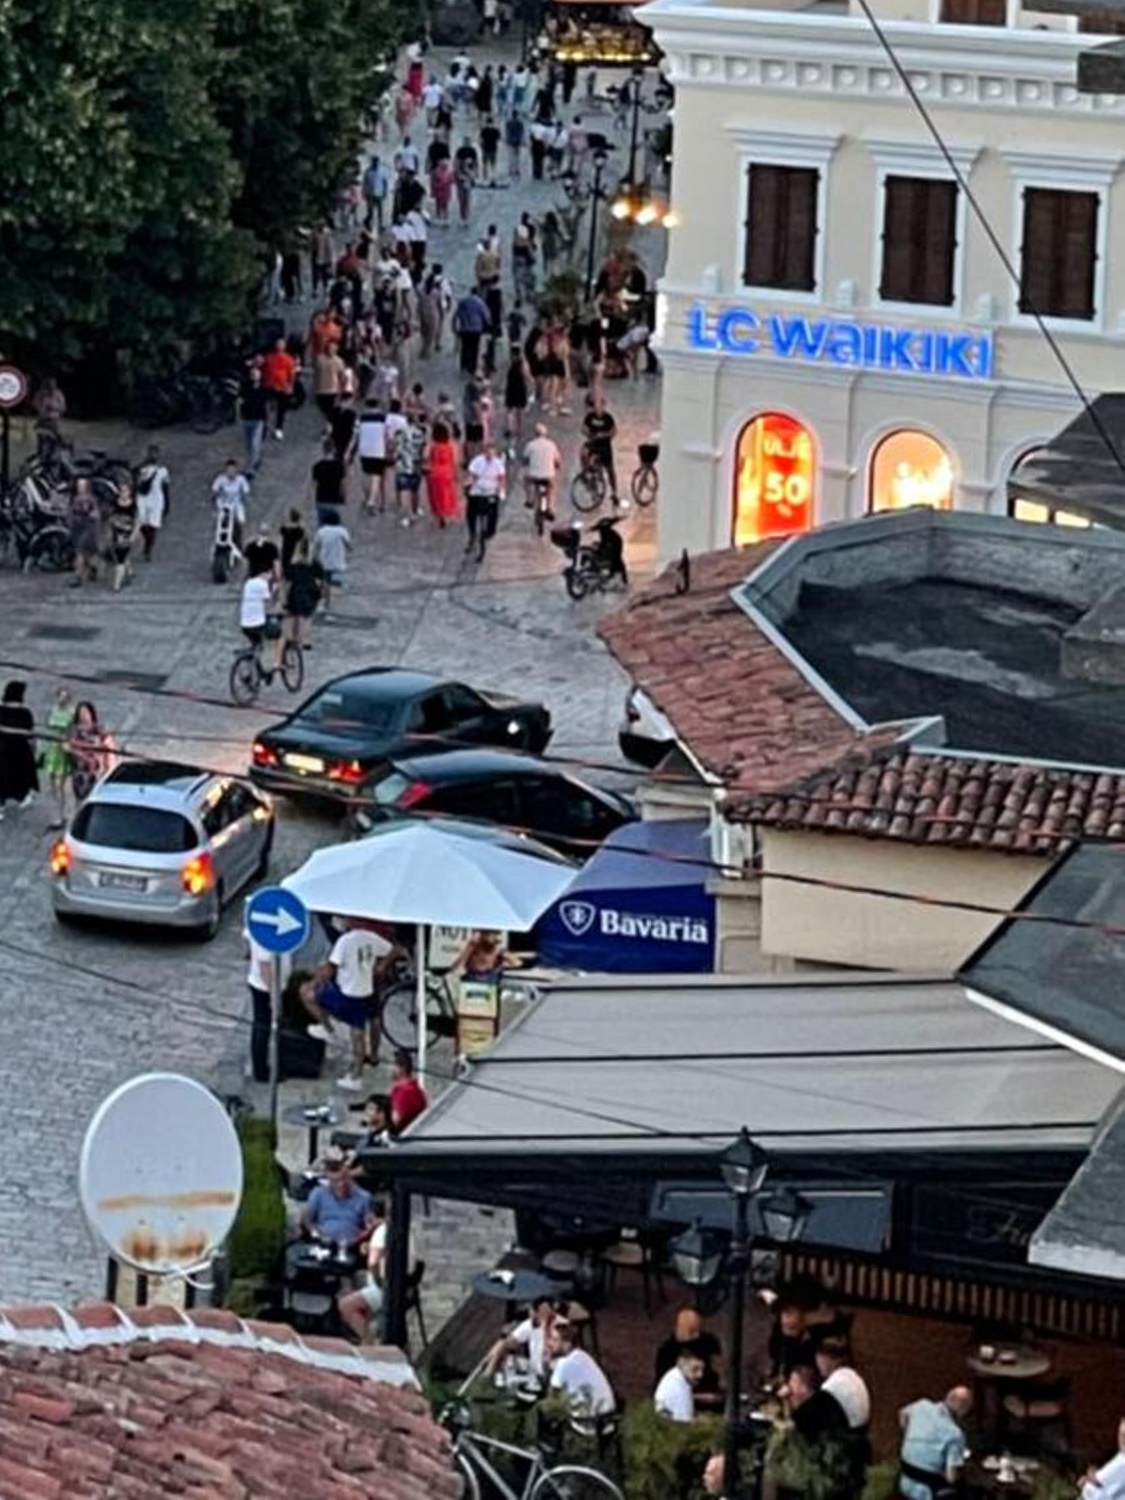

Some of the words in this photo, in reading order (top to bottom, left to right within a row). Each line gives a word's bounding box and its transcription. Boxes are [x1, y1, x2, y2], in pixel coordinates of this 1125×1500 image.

[687, 301, 761, 354] LC
[765, 472, 808, 506] 50
[600, 908, 708, 944] Bavaria
